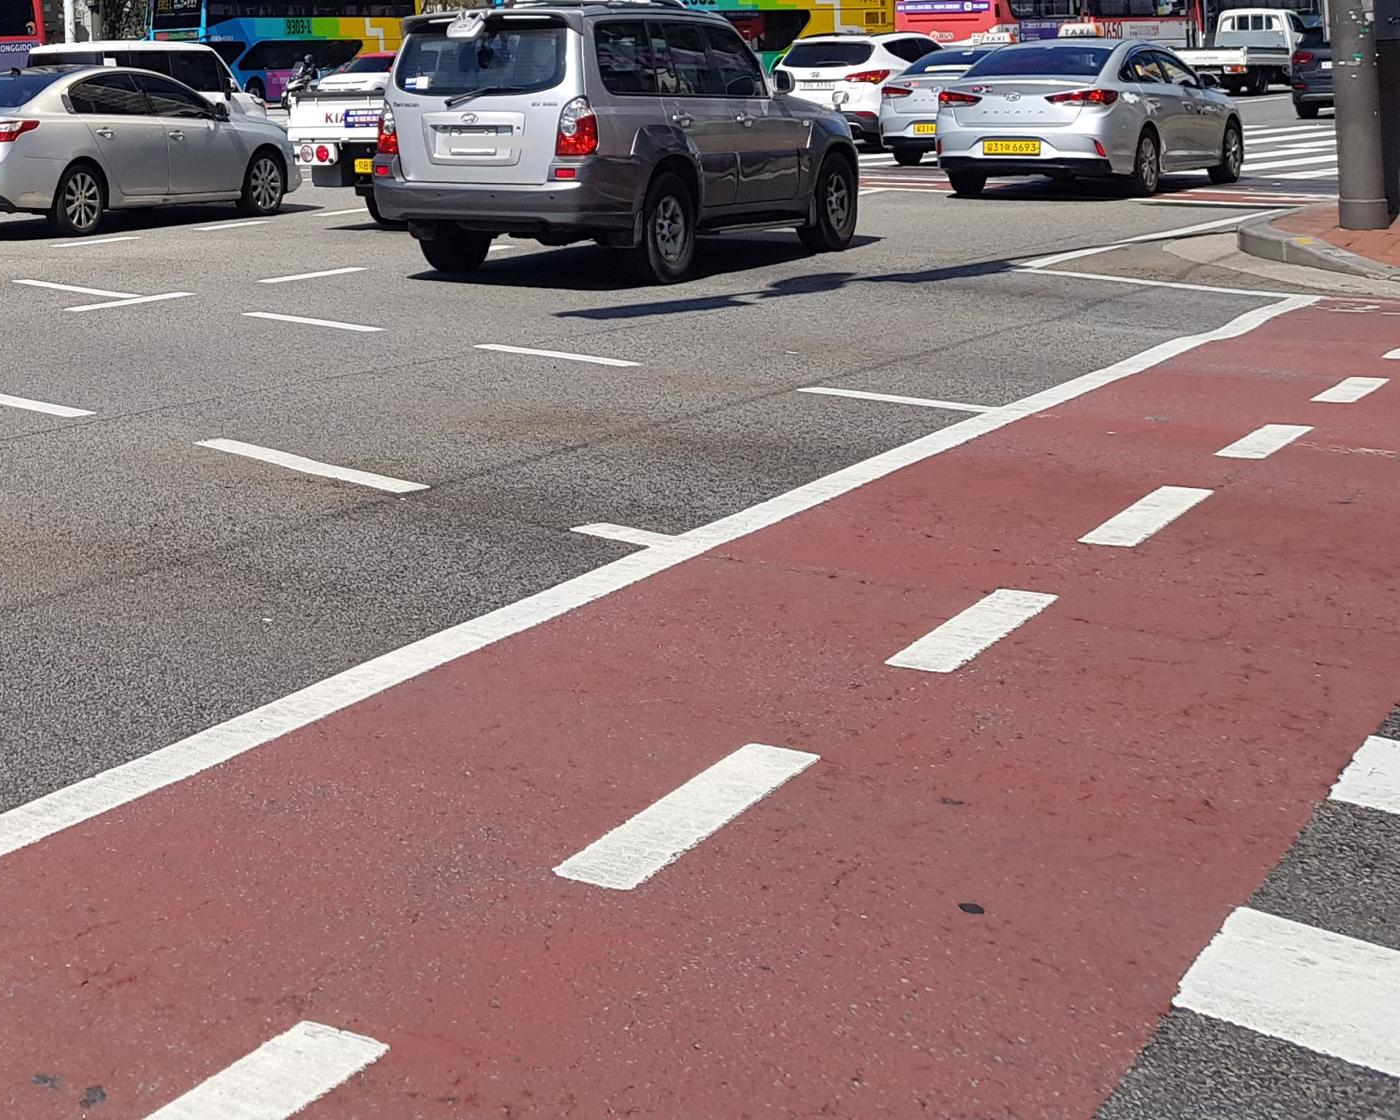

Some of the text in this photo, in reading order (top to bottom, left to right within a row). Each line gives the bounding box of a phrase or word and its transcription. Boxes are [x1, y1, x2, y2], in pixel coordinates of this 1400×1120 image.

[287, 19, 312, 34] 9303-1
[1065, 28, 1090, 36] TAXI
[1102, 22, 1123, 40] 1650
[1012, 143, 1036, 151] 6693
